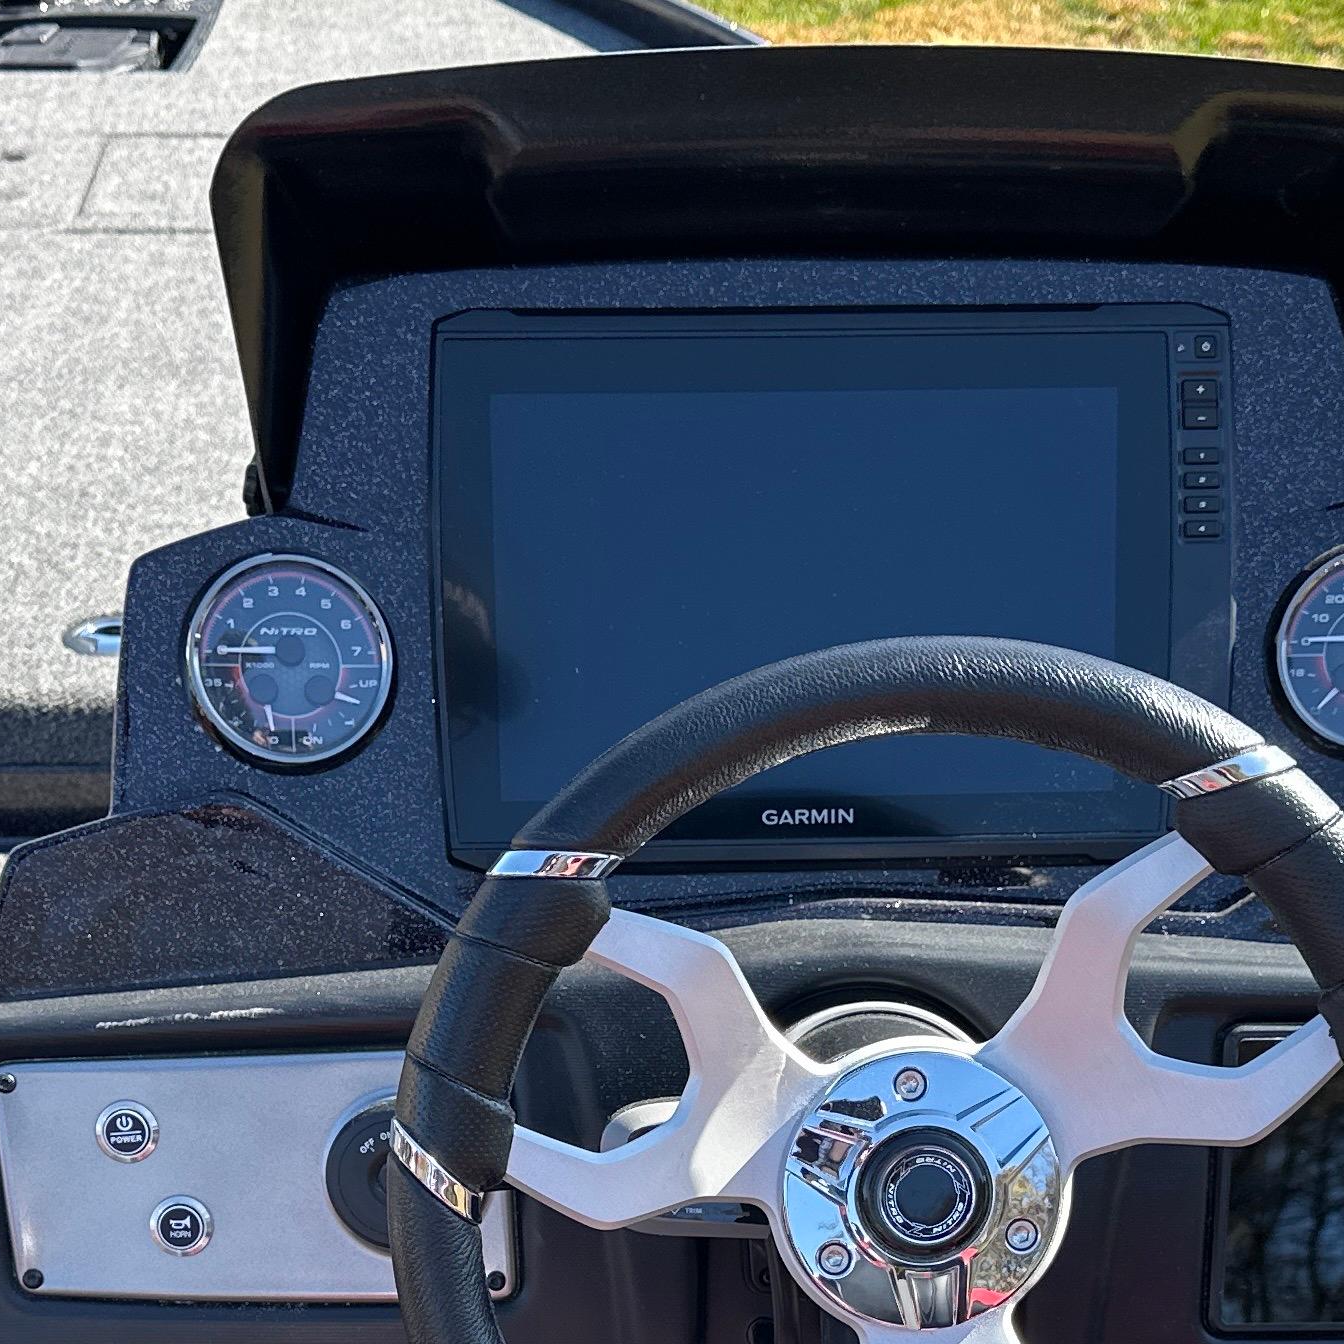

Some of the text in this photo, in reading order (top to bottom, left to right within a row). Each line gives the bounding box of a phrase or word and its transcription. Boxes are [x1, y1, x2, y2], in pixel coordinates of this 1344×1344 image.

[268, 586, 279, 597] 3
[295, 586, 307, 597] 4
[242, 598, 254, 609] 2
[320, 599, 332, 609] 5
[1312, 613, 1330, 623] 10
[226, 618, 235, 629] 1
[340, 619, 352, 630] 6
[259, 627, 318, 636] NITRO
[351, 646, 362, 656] 7
[359, 680, 378, 688] UP
[761, 808, 855, 826] GARMIN
[110, 1134, 143, 1144] POWER
[359, 1137, 375, 1154] OFF
[169, 1230, 192, 1239] HORN
